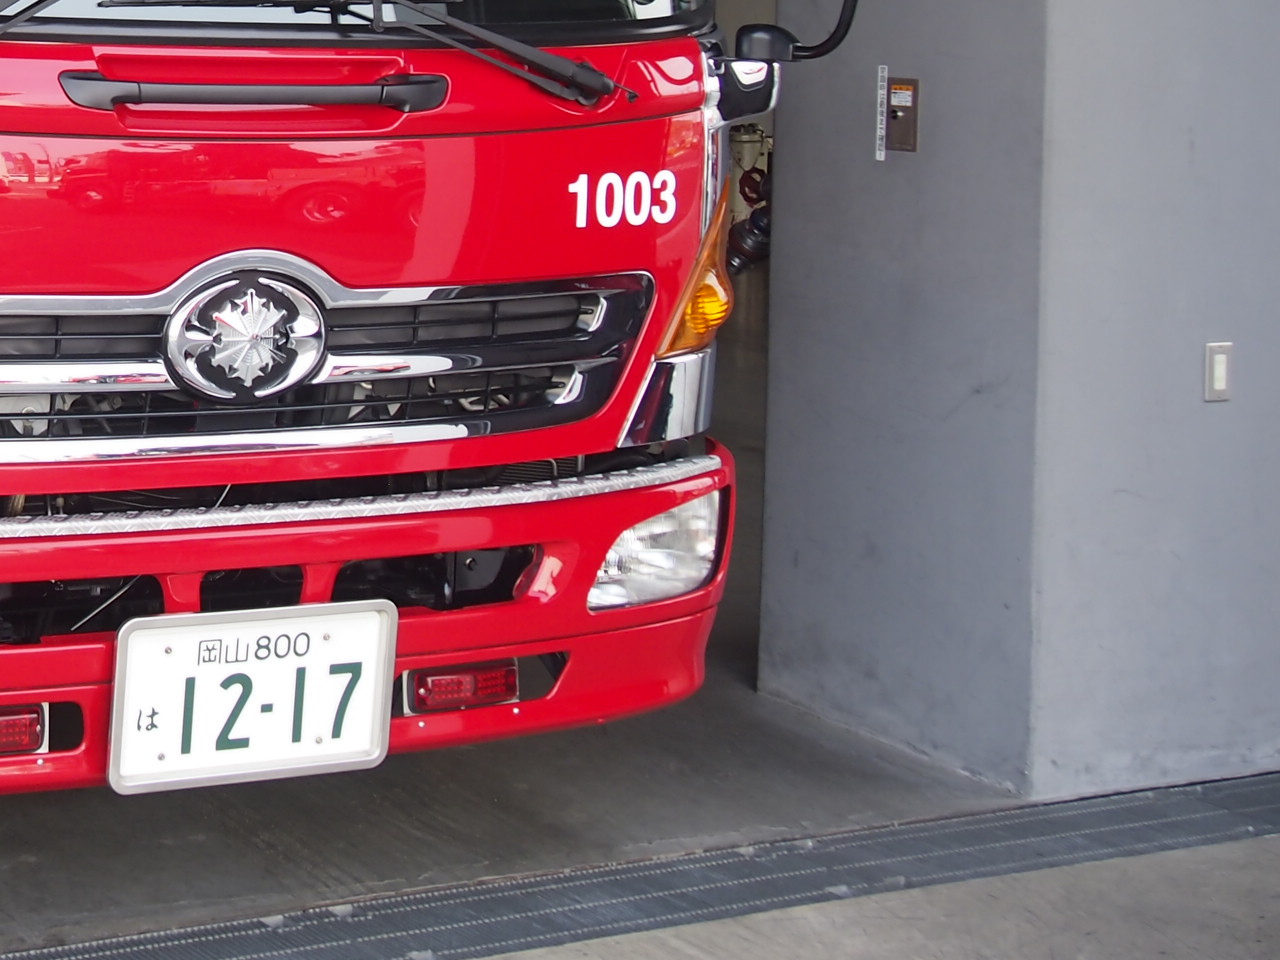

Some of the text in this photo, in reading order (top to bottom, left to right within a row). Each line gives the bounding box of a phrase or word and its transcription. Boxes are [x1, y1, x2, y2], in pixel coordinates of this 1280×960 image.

[568, 169, 677, 228] 1003
[137, 662, 362, 754] は 12-17
